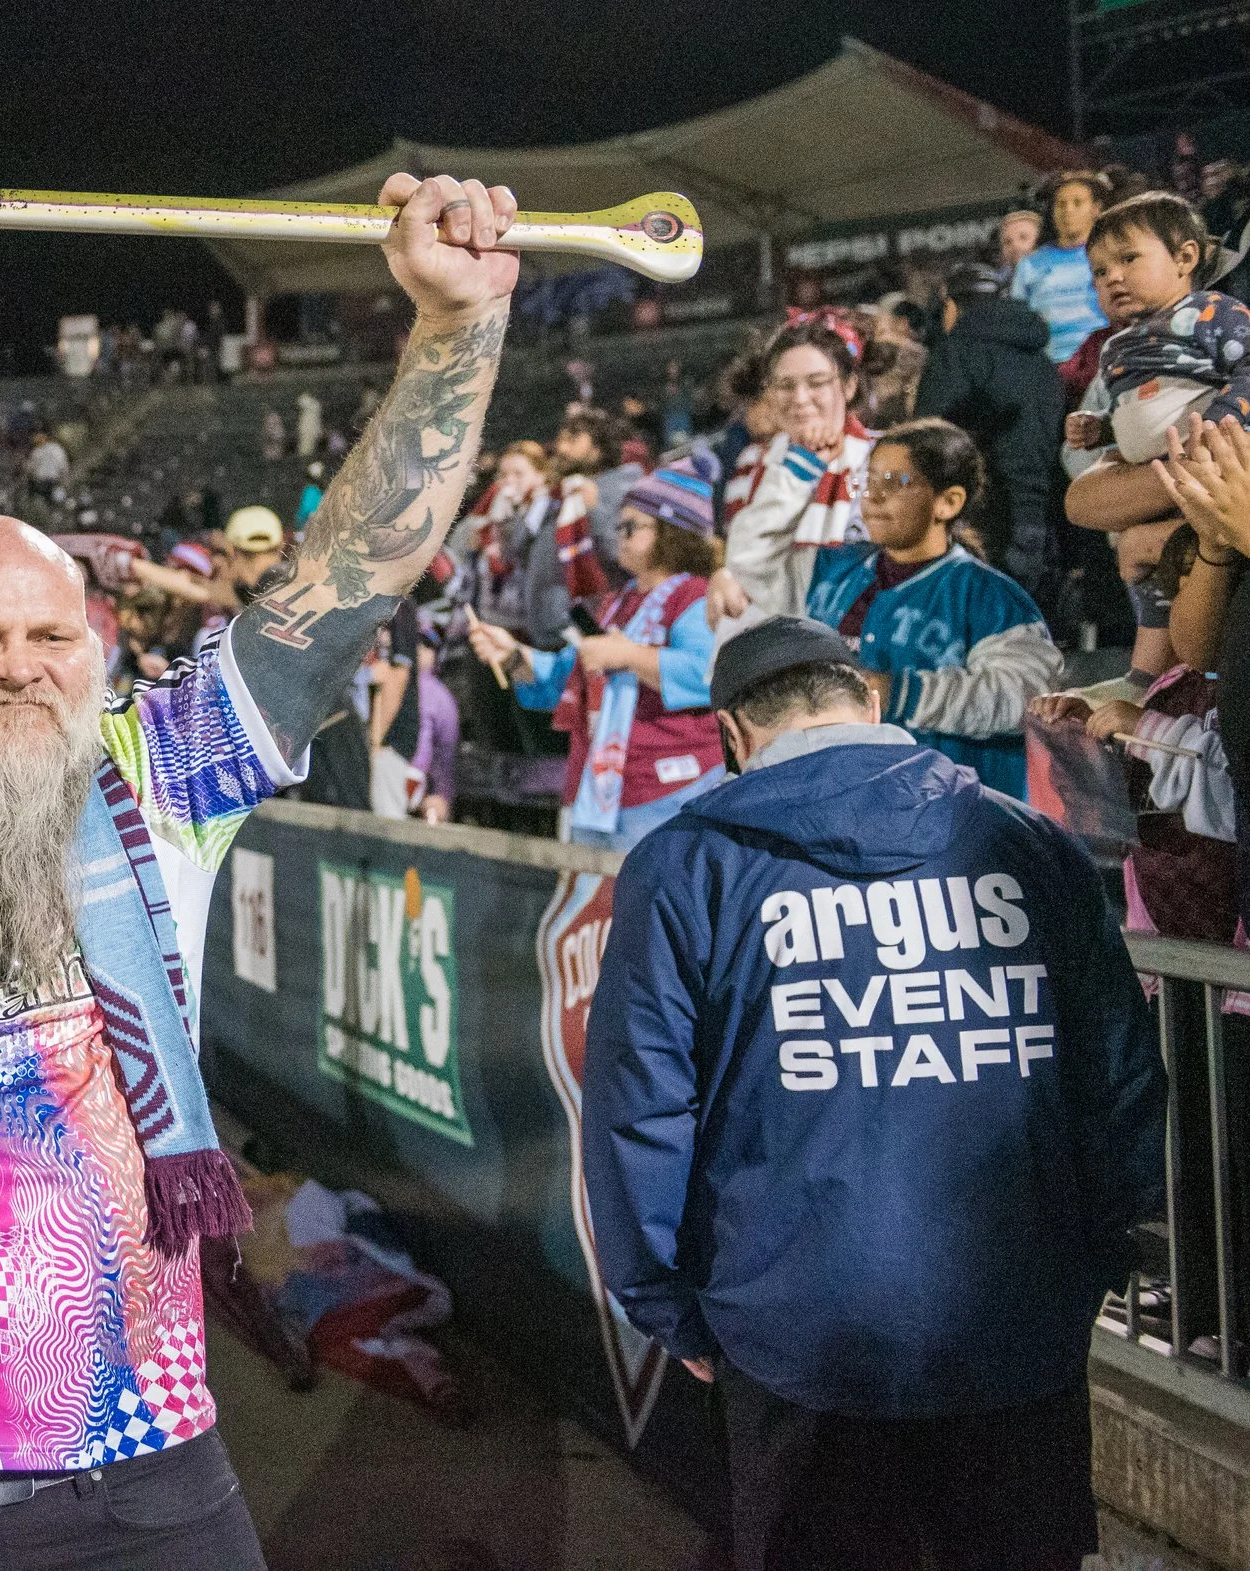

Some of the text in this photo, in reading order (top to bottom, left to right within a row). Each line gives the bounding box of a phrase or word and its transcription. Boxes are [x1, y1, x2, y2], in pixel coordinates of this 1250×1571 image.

[760, 872, 1030, 970] argus
[771, 964, 1048, 1032] EVENT
[779, 1025, 1055, 1092] STAFF
